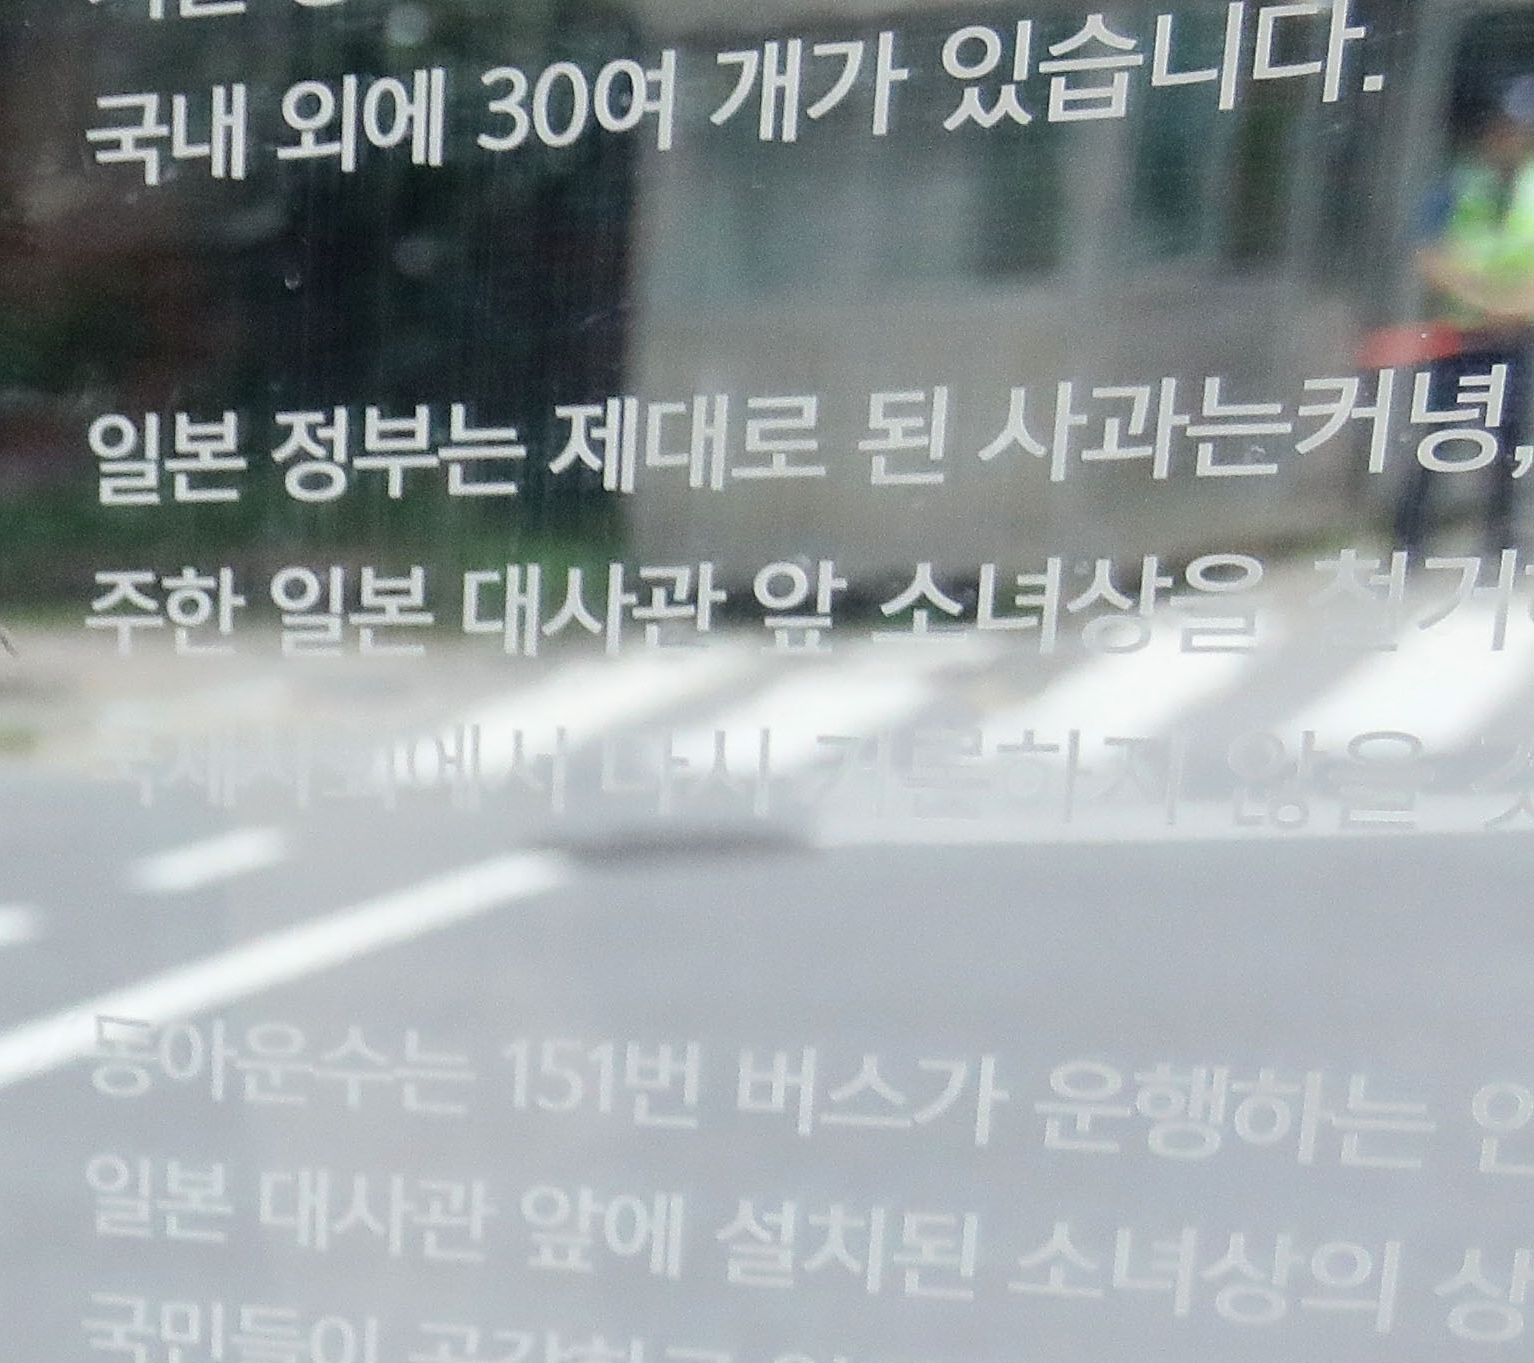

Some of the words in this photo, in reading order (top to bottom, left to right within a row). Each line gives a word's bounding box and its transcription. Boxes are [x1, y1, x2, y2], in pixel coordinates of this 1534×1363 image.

[86, 83, 246, 186] 국내
[277, 67, 445, 173] 외에
[476, 49, 678, 152] 30여
[710, 31, 908, 143] 개가
[942, 0, 1385, 133] 있습니다.
[88, 410, 247, 505] 일본
[271, 402, 526, 500] 정부는
[548, 393, 827, 494] 제대로
[857, 385, 947, 486] 된
[86, 566, 245, 657] 주한
[270, 566, 434, 658] 일본
[462, 561, 727, 658] 대사관
[753, 559, 848, 656] 앞
[871, 553, 1269, 656] 소녀상을
[92, 1014, 477, 1115] 동아운수는
[507, 1038, 700, 1129] 151번
[737, 1045, 1011, 1148] 버스가
[1033, 1060, 1438, 1167] 운행하는
[85, 1154, 234, 1245] 일본
[259, 1166, 496, 1264] 대사관
[520, 1184, 684, 1281] 앞에
[715, 1197, 979, 1300] 설치된
[1007, 1221, 1402, 1334] 소녀상의
